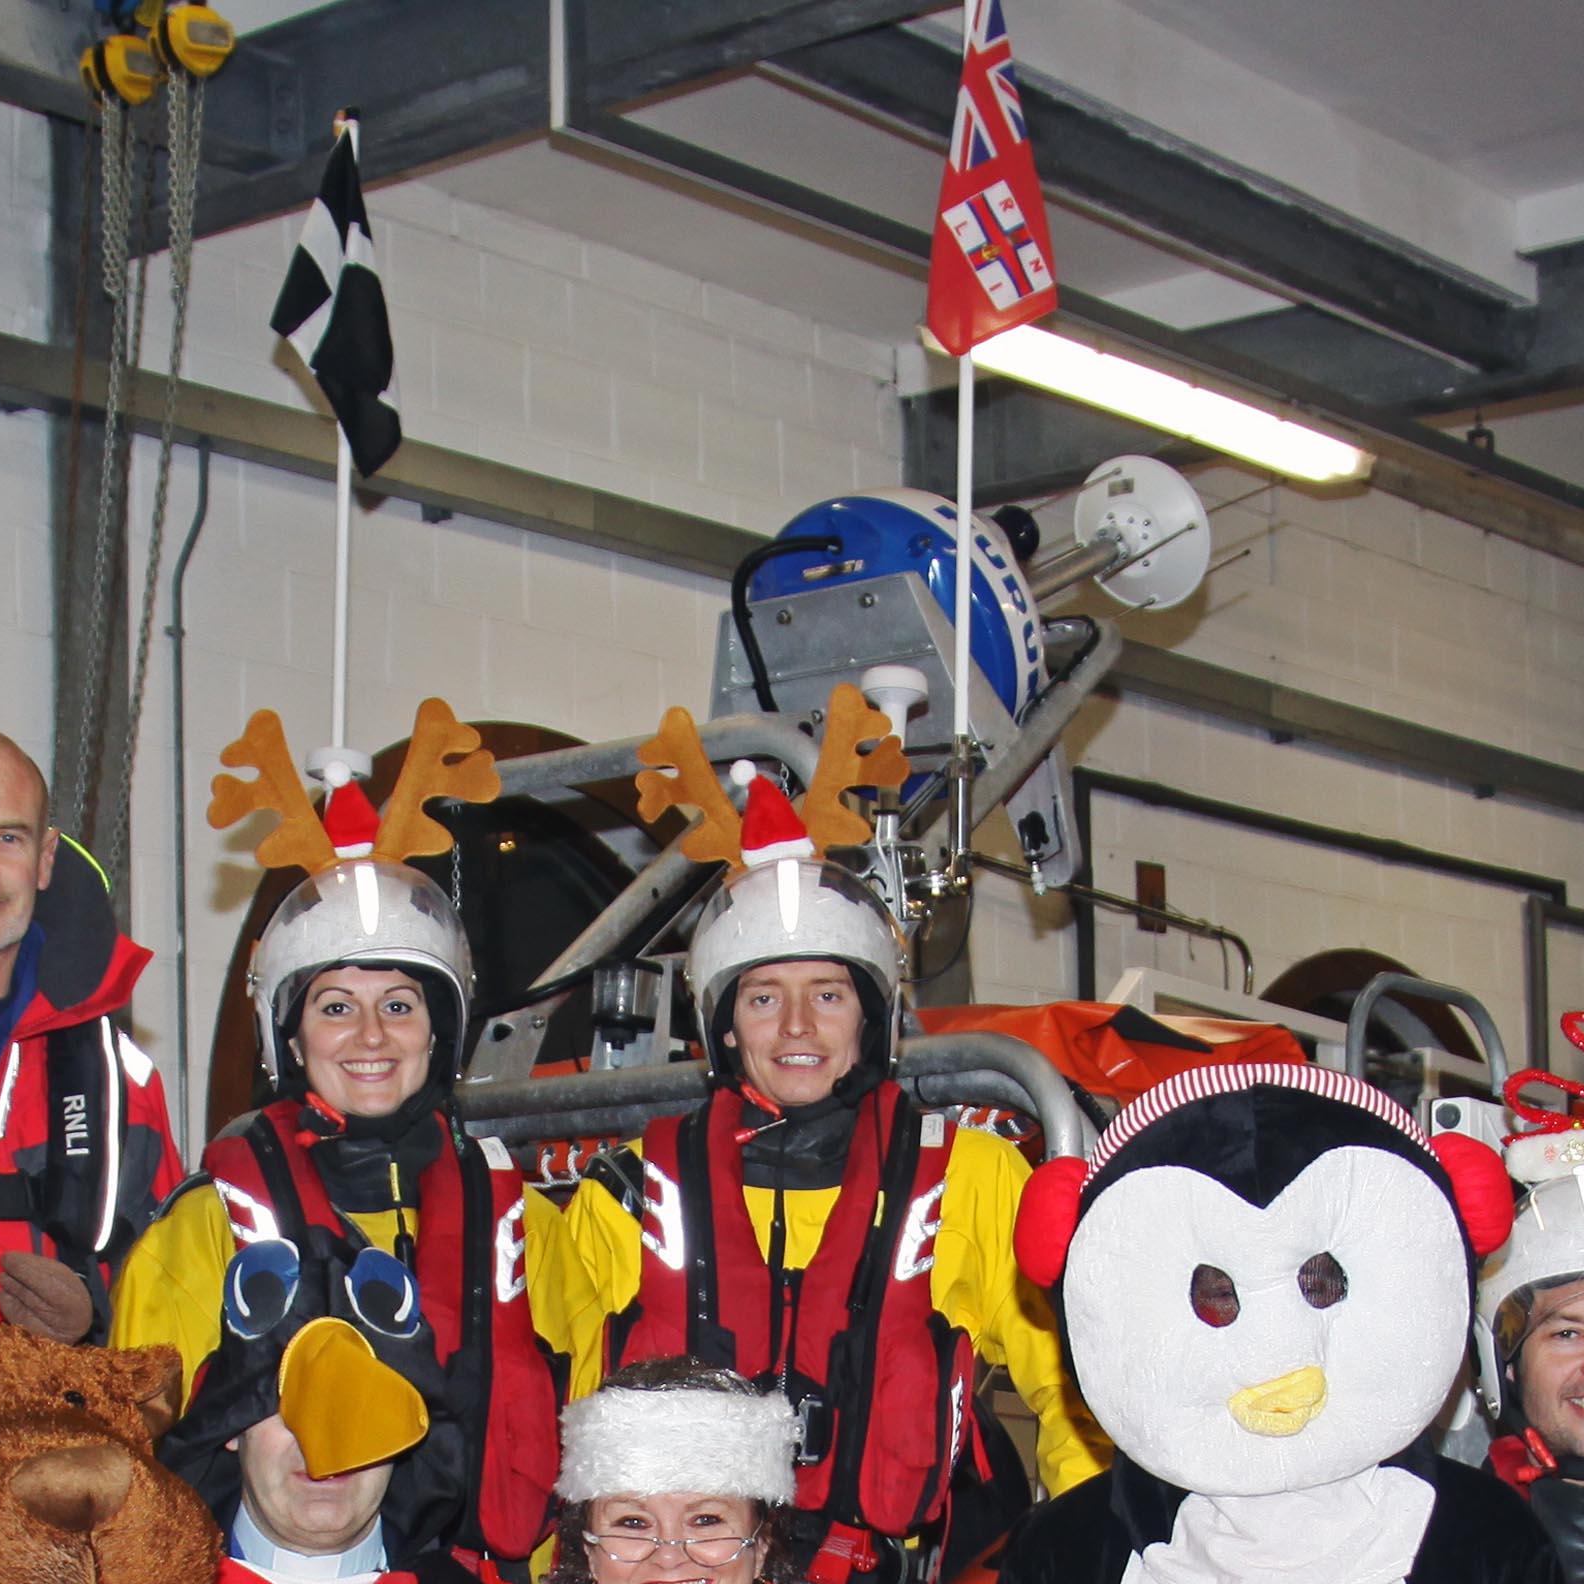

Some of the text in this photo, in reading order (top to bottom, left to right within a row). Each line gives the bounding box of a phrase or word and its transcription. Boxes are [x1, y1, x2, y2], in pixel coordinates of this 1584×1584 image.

[954, 219, 970, 237] L
[998, 196, 1044, 274] R N
[62, 1094, 90, 1156] RNLI
